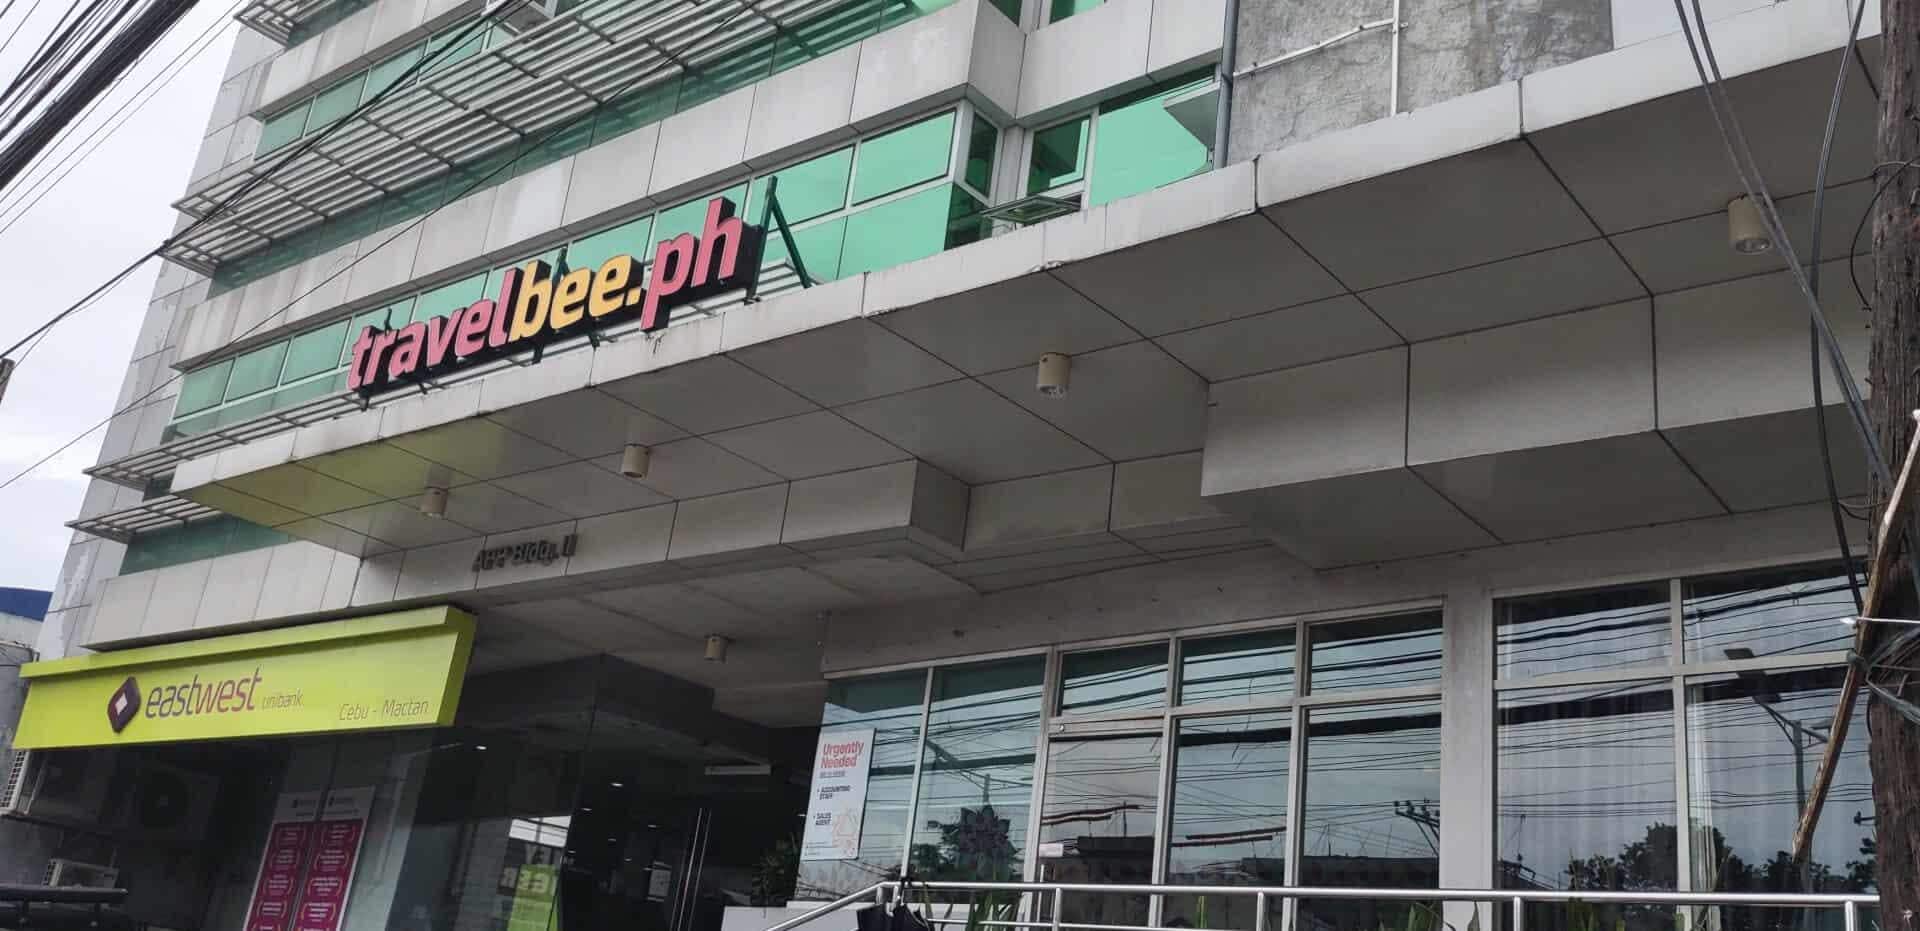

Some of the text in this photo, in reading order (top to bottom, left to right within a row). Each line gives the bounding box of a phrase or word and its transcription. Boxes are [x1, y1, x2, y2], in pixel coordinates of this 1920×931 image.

[346, 196, 746, 392] travelbee.ph
[145, 666, 262, 719] eastwest
[339, 702, 369, 721] Cebu
[382, 698, 429, 718] Mactan
[823, 741, 864, 757] Urgently
[820, 755, 857, 769] Needed
